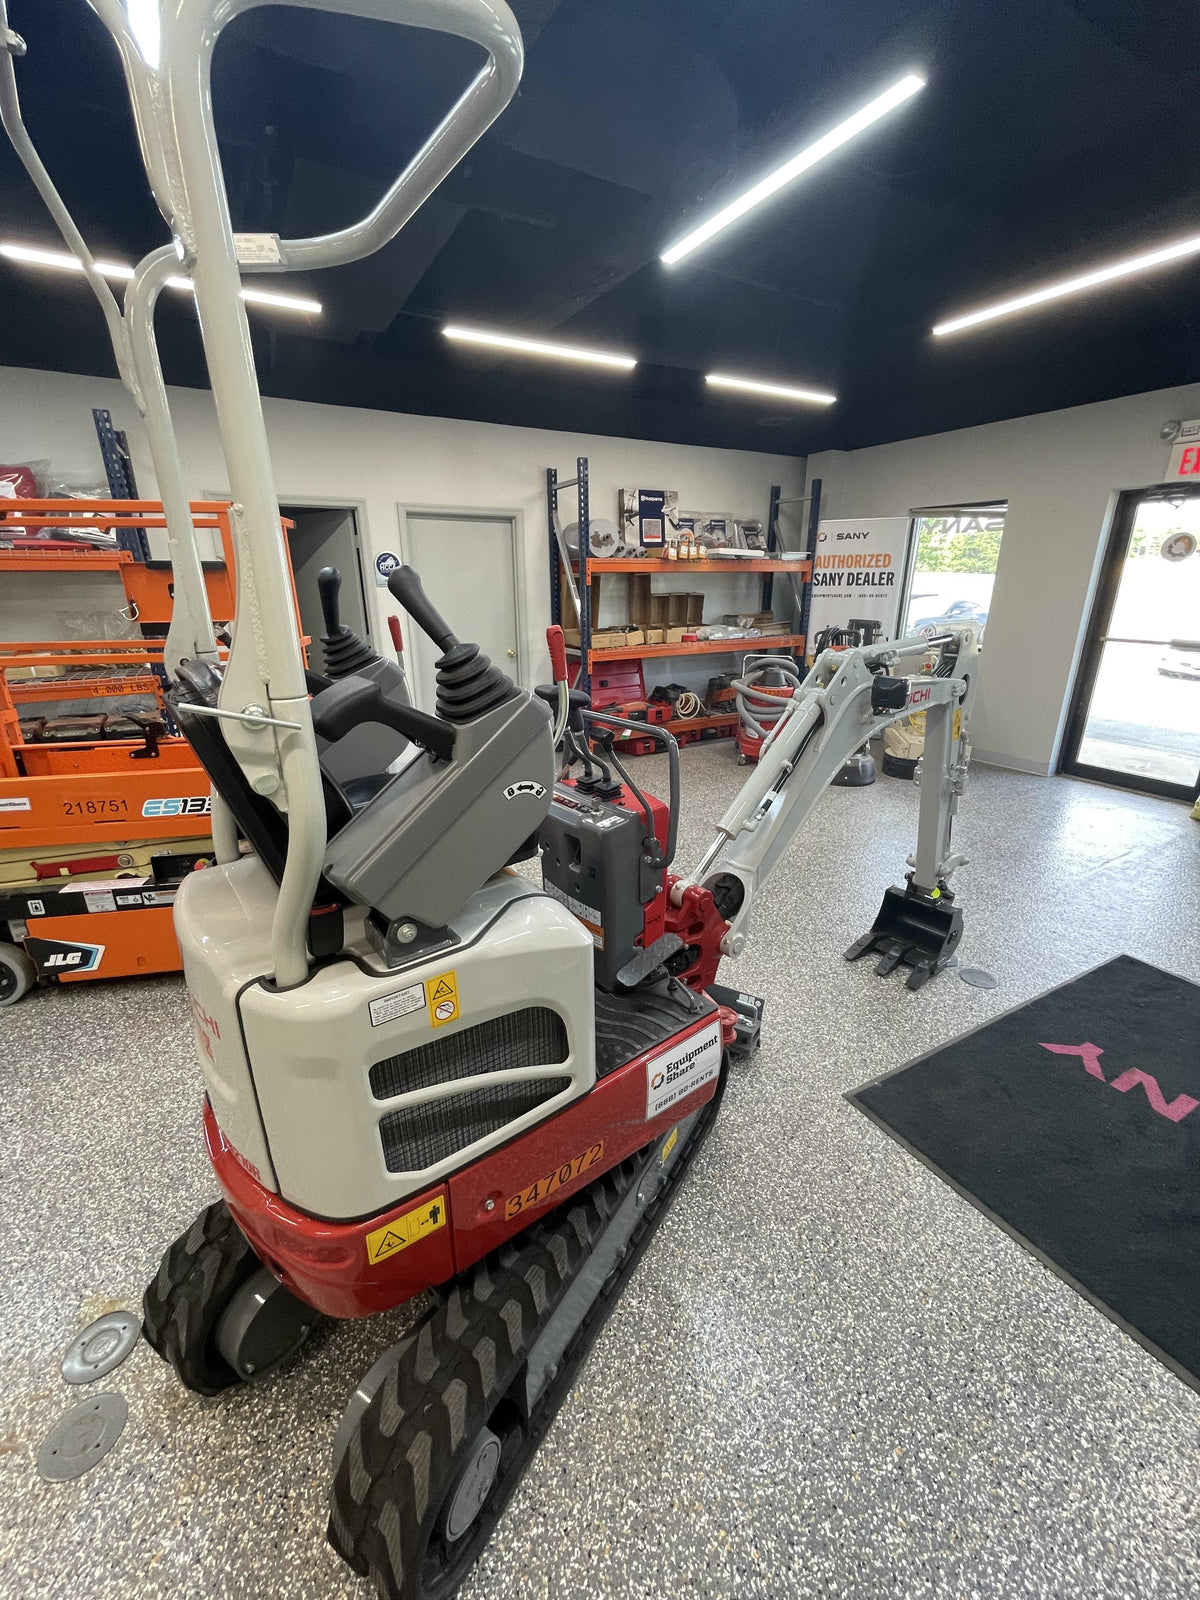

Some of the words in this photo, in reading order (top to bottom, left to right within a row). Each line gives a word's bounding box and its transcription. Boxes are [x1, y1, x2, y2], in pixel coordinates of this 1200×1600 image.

[836, 532, 870, 541] SANY
[815, 553, 892, 570] AUTHORIZED
[813, 572, 844, 587] SANY
[849, 571, 895, 587] DEALER
[130, 683, 150, 692] LBS
[63, 799, 129, 815] 218751
[43, 952, 82, 967] JLG
[665, 1035, 719, 1075] Equipment
[665, 1062, 696, 1085] Share
[654, 1092, 677, 1111] (888)
[508, 1143, 602, 1217] 347072
